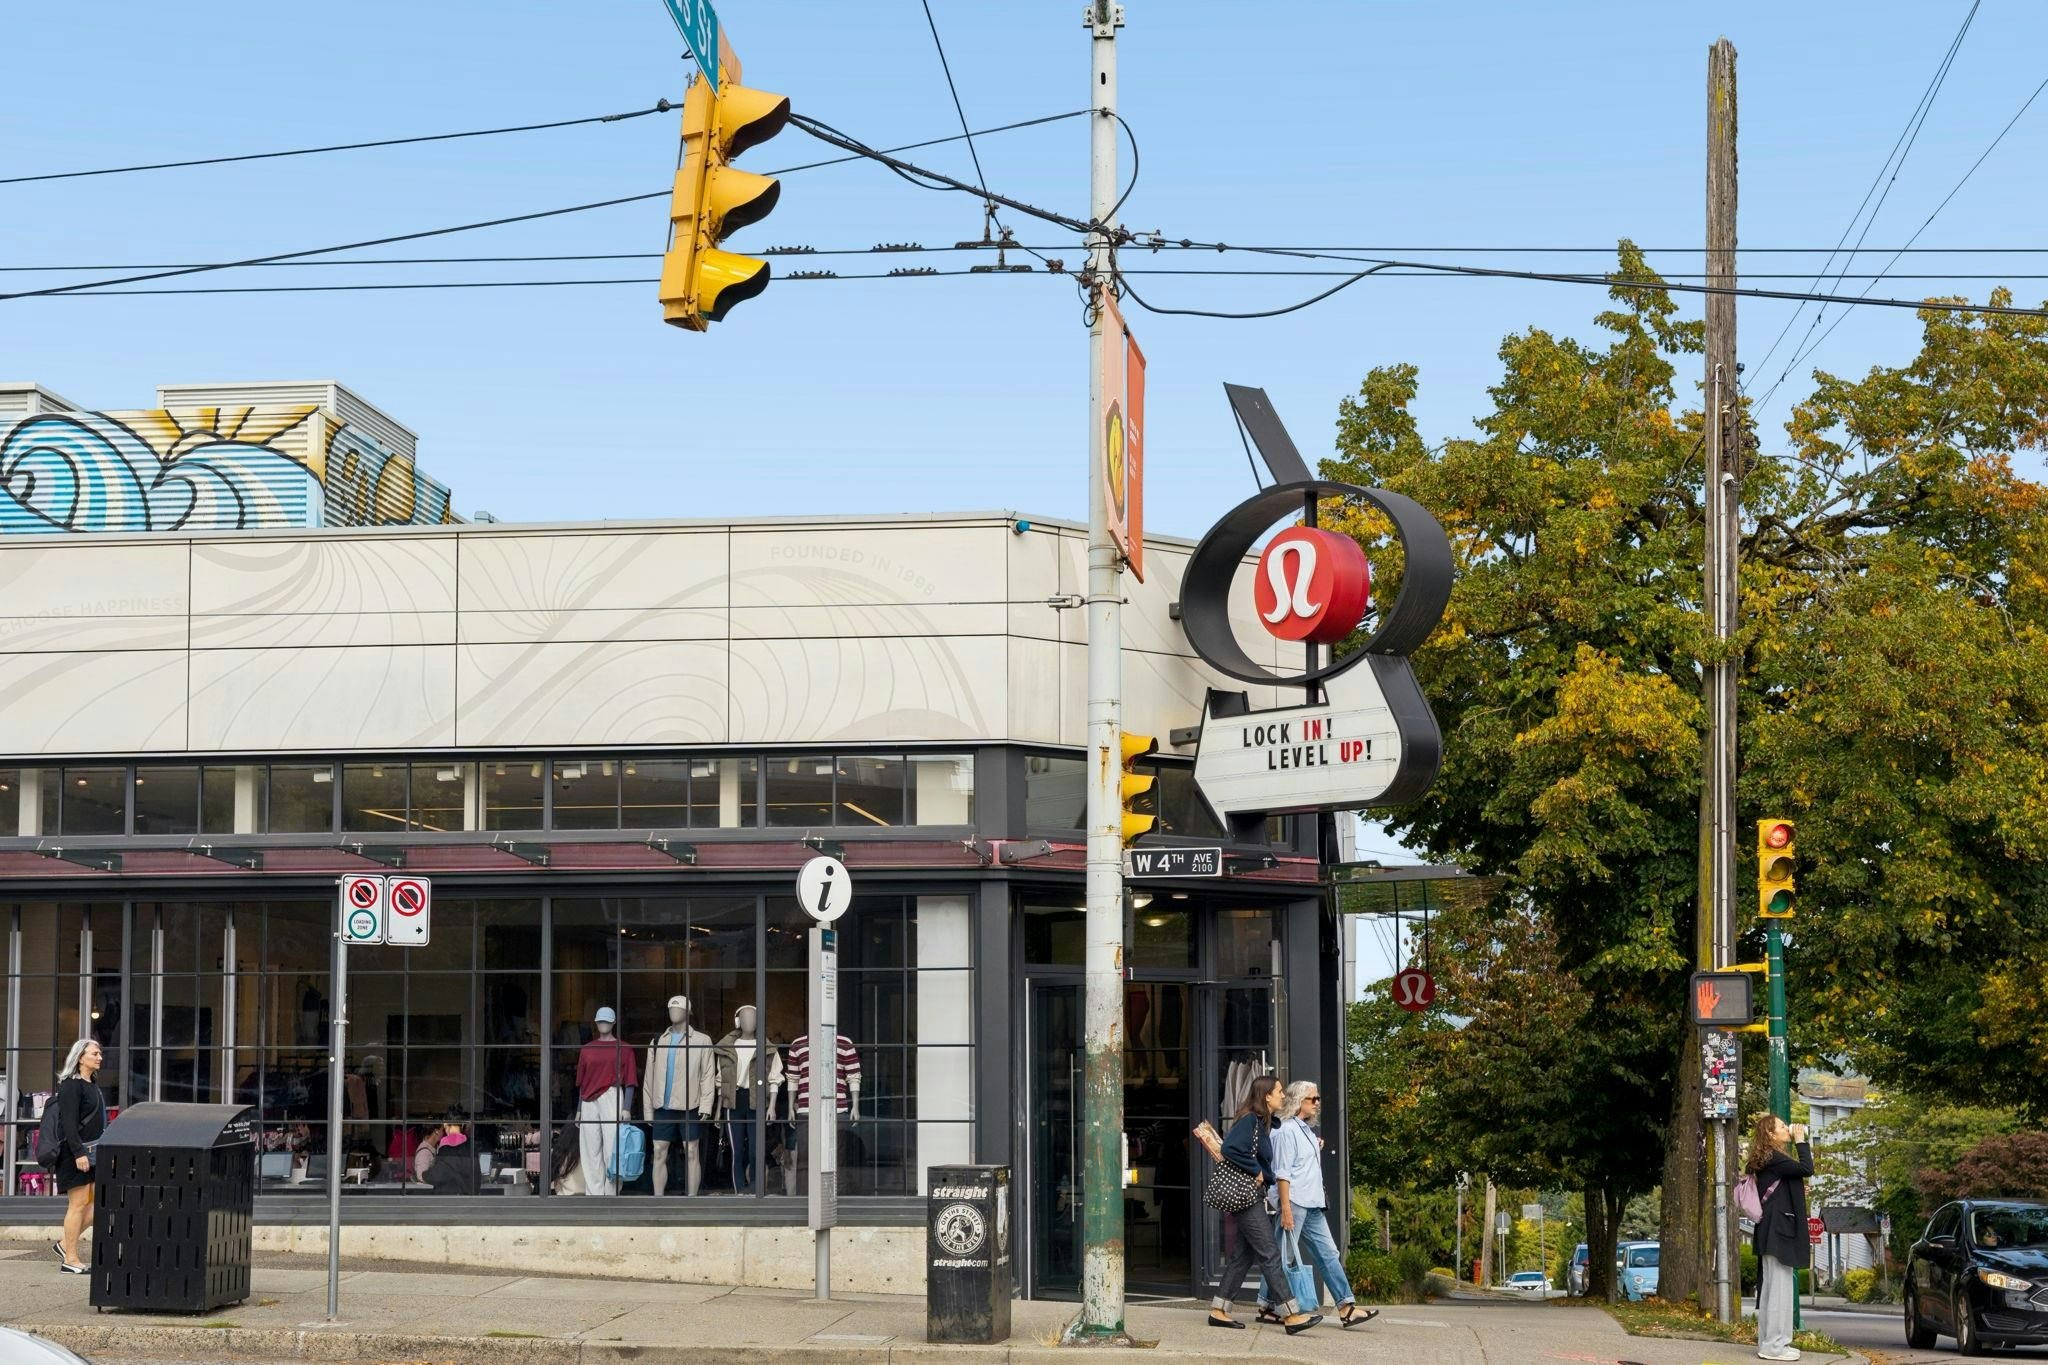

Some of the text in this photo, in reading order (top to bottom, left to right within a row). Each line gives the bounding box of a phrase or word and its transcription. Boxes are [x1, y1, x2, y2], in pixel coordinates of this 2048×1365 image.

[697, 0, 712, 69] St
[770, 545, 936, 597] FOUNDED IN 1998
[0, 598, 184, 636] CHOOSE HAPPINESS
[1243, 718, 1332, 748] LOCK IN!
[1268, 739, 1372, 770] LEVEL UP!
[1136, 853, 1212, 872] W 4TH AVE
[1191, 863, 1213, 872] 2100
[932, 1186, 988, 1199] straight
[947, 1208, 960, 1217] THE
[962, 1208, 981, 1226] STREET
